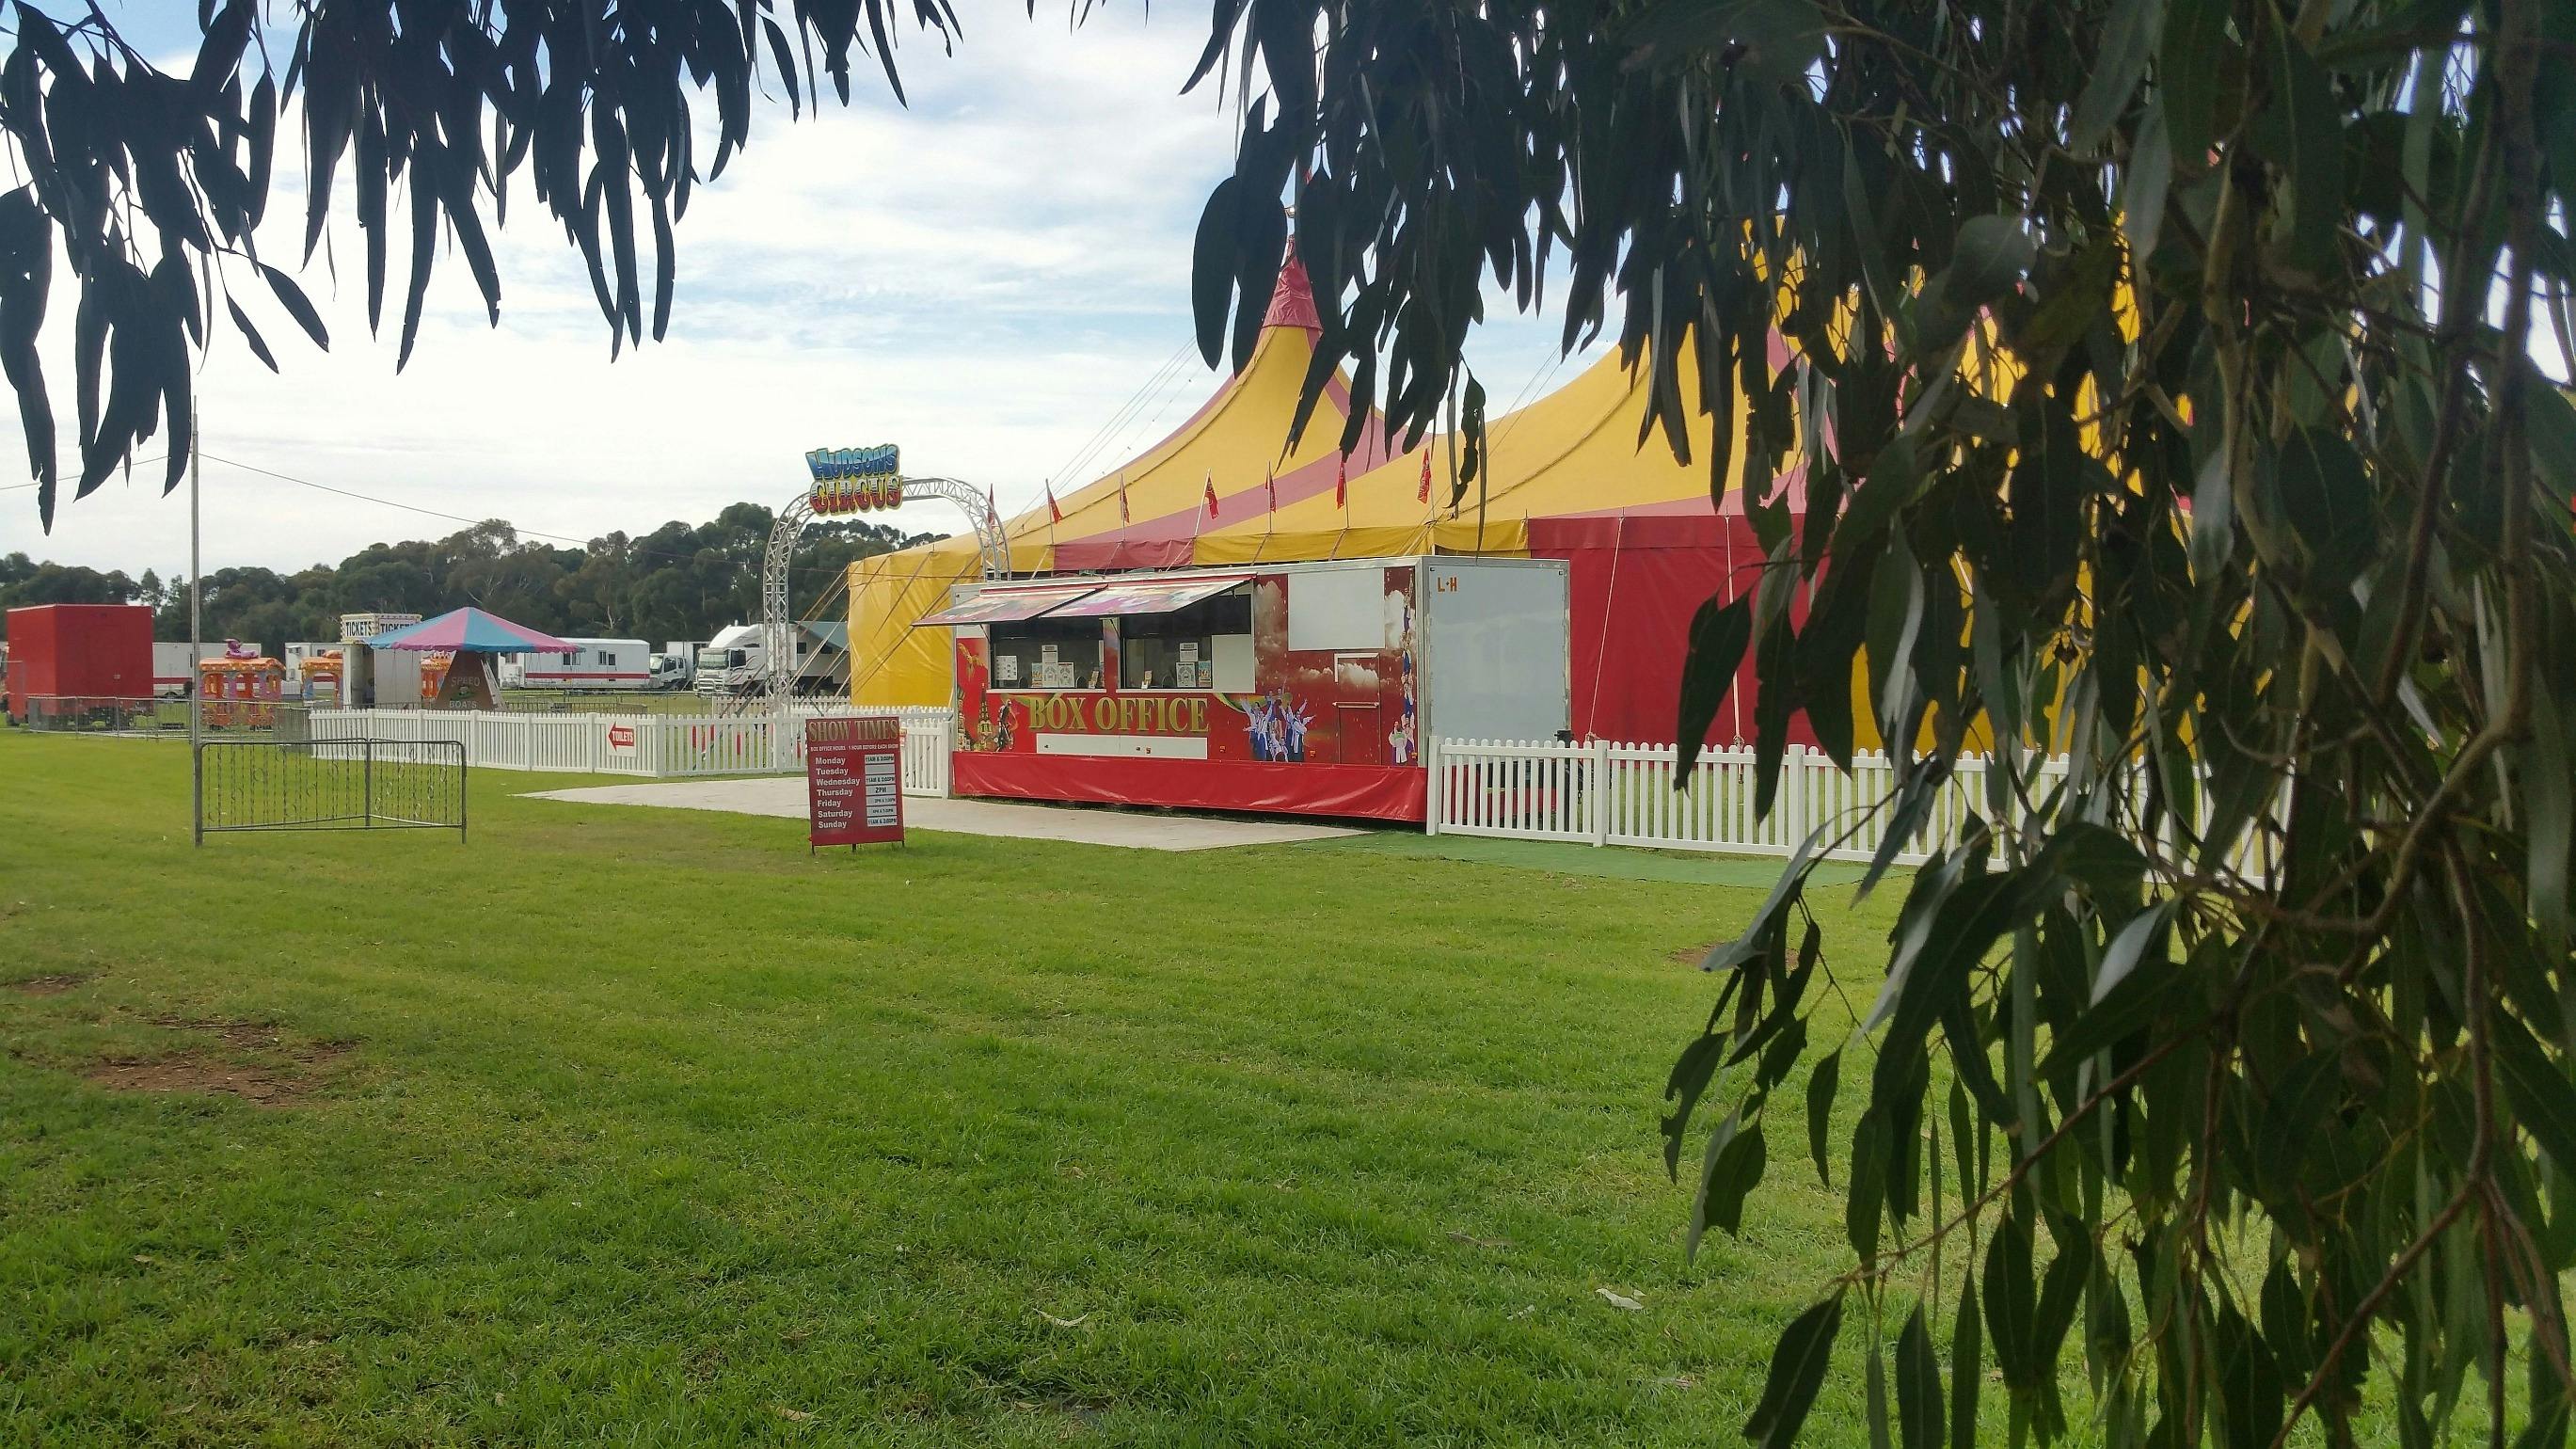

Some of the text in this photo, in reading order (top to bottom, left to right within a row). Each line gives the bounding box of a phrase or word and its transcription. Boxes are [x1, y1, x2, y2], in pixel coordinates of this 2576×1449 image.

[805, 443, 899, 480] HUDSONS
[810, 475, 902, 514] CIRCUS
[345, 621, 373, 637] TICKETS
[1028, 695, 1210, 733] BOX OFFICE
[612, 730, 634, 742] TOILETS
[809, 720, 851, 741] SHOW
[854, 719, 898, 740] TIMES
[816, 778, 861, 787] Wednesday
[817, 788, 853, 797] Thursday
